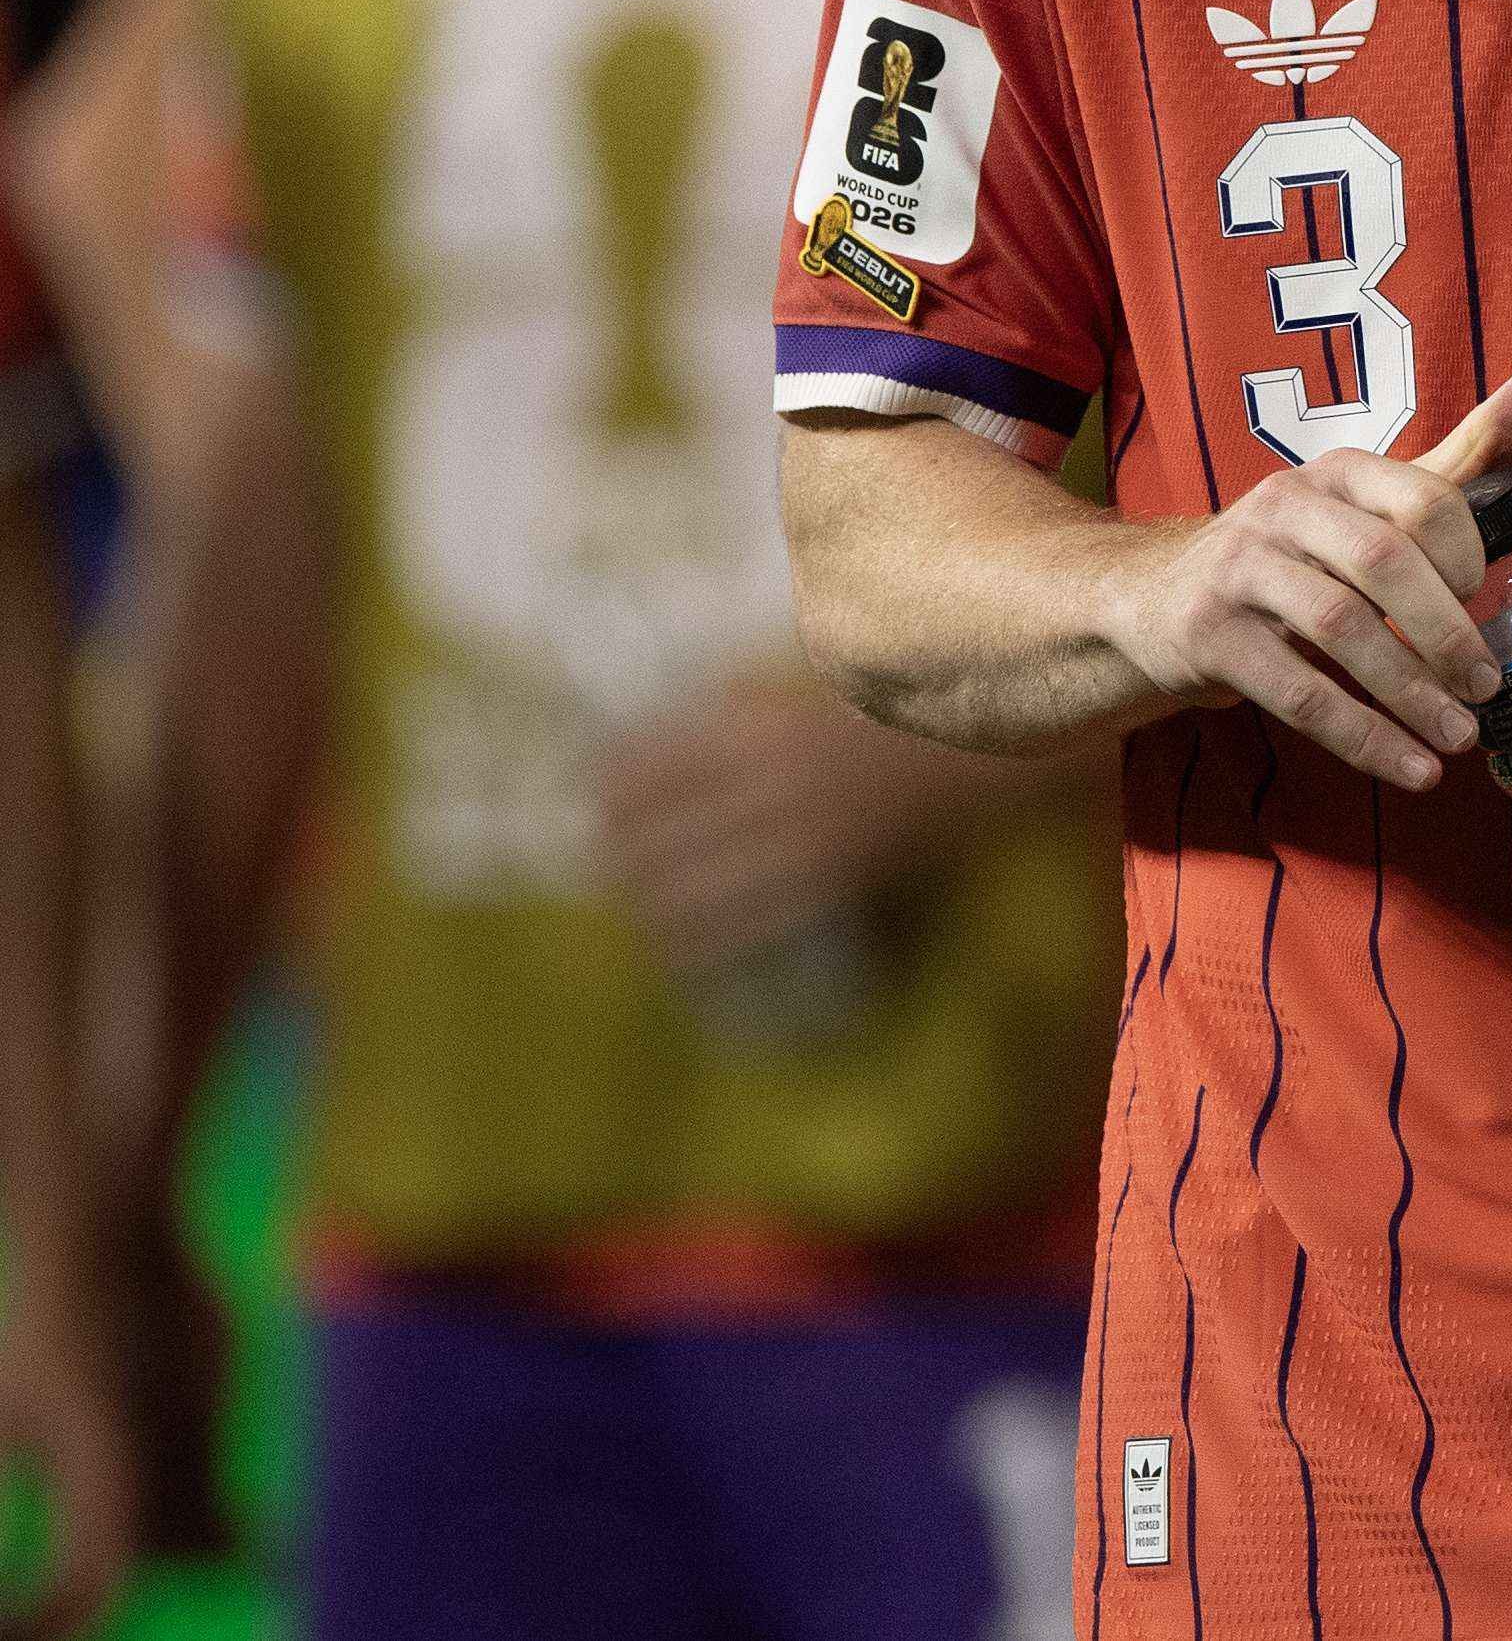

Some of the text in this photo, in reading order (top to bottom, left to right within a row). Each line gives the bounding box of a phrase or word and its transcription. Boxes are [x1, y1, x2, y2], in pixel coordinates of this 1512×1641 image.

[862, 143, 900, 171] FIFA
[837, 174, 919, 210] WORLD CUP
[833, 192, 917, 236] 026
[838, 238, 911, 294] DEBUT
[1217, 115, 1417, 468] 3
[1134, 1521, 1160, 1531] LICENSED
[1135, 1536, 1160, 1547] PRODUCT
